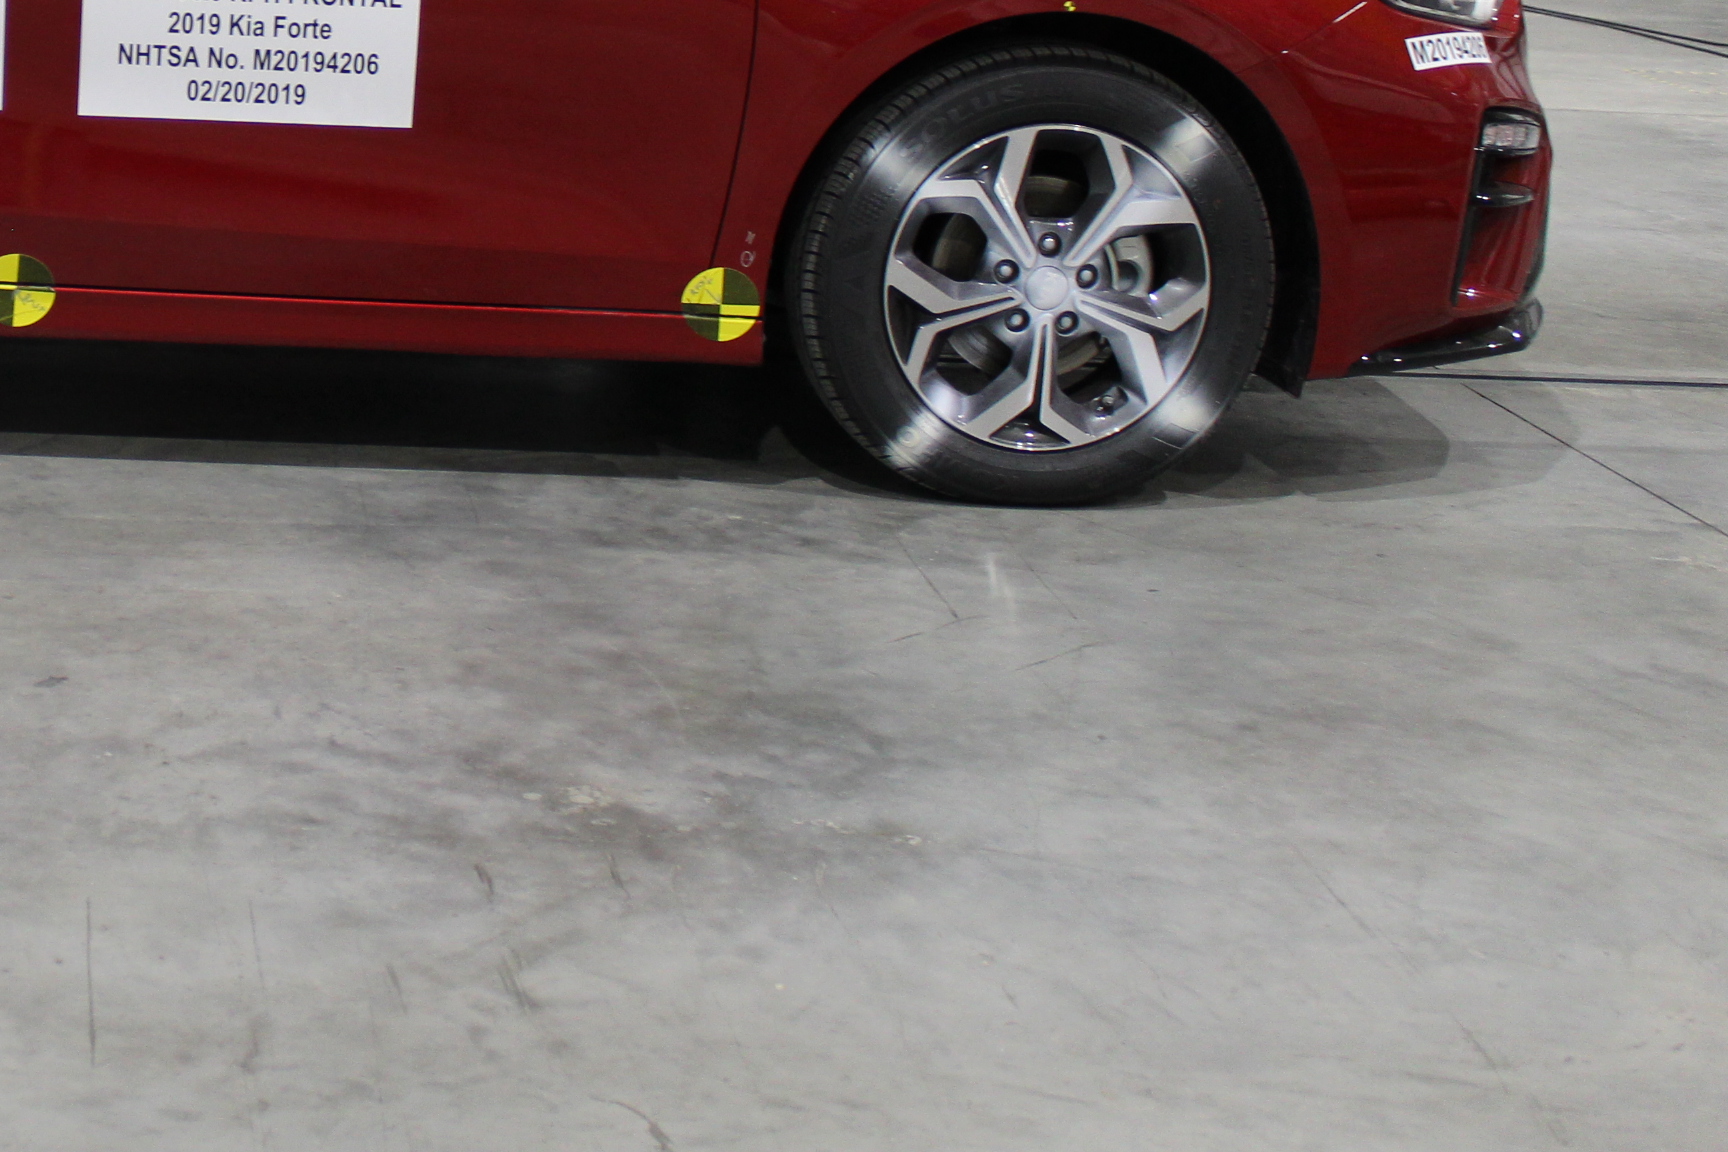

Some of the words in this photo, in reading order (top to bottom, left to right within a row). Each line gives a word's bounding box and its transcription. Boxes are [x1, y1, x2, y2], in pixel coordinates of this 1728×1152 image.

[168, 11, 221, 35] 2019
[229, 13, 265, 37] Kia
[273, 16, 332, 40] Forte
[117, 43, 200, 69] NHTSA
[207, 47, 245, 70] No.
[252, 48, 379, 75] M20194206
[187, 79, 306, 105] 02/20/2019
[899, 82, 1026, 160] SOLUS
